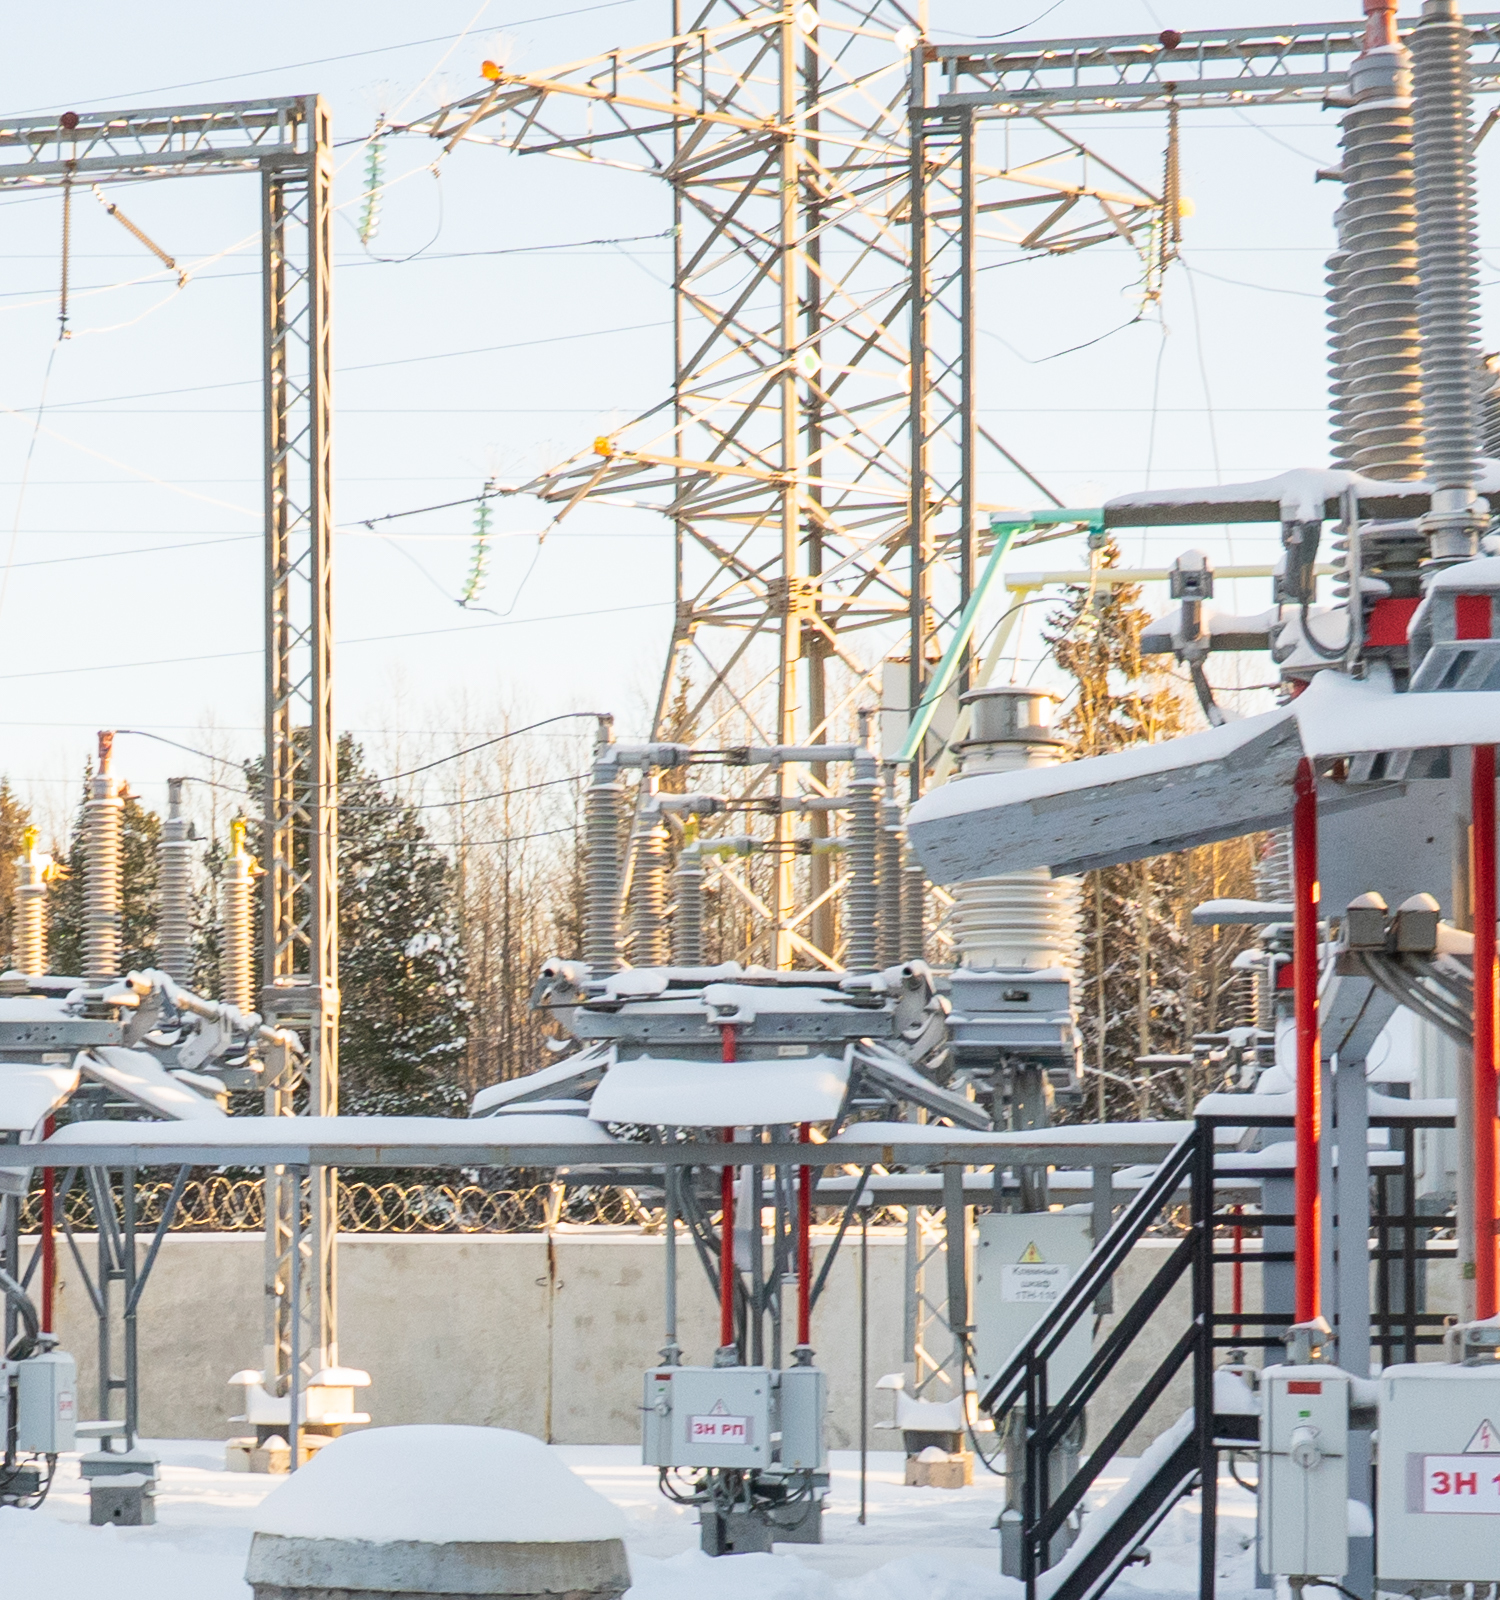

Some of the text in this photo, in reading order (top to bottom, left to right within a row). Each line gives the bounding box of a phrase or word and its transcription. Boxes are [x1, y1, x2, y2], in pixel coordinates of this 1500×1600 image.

[694, 1423, 745, 1436] ЗН РП
[1431, 1471, 1478, 1495] ЗН
